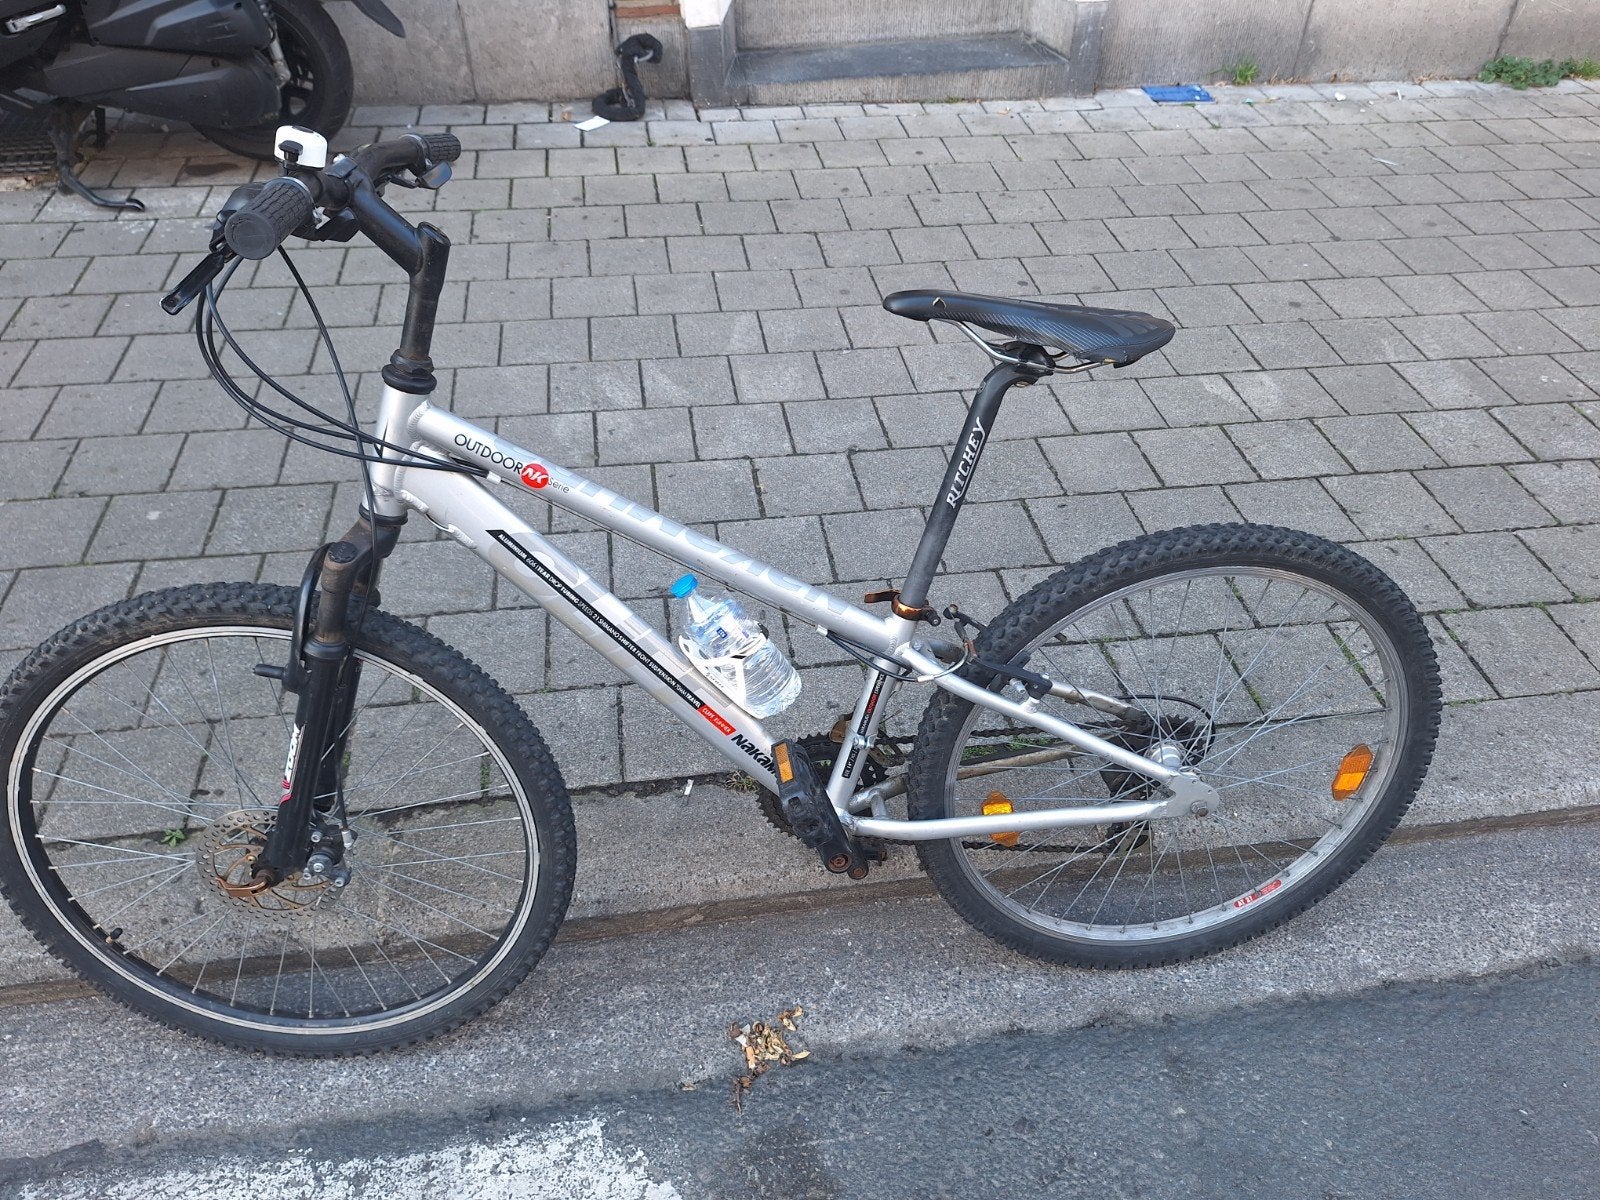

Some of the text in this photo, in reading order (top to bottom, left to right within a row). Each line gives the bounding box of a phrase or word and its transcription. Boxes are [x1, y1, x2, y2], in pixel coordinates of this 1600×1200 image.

[454, 433, 524, 475] OUTDOOR
[946, 416, 985, 508] RITCHEY
[499, 533, 528, 559] ALUMINIUM
[538, 566, 551, 579] TEAR
[549, 576, 562, 589] DROP
[561, 586, 580, 604] TUBING
[592, 613, 600, 621] 21
[598, 618, 620, 638] SHIMANO
[618, 636, 637, 653] SHIFTER
[635, 649, 651, 664] FRONT
[649, 661, 676, 687] SUSPENSION
[686, 693, 702, 709] TRAVEL
